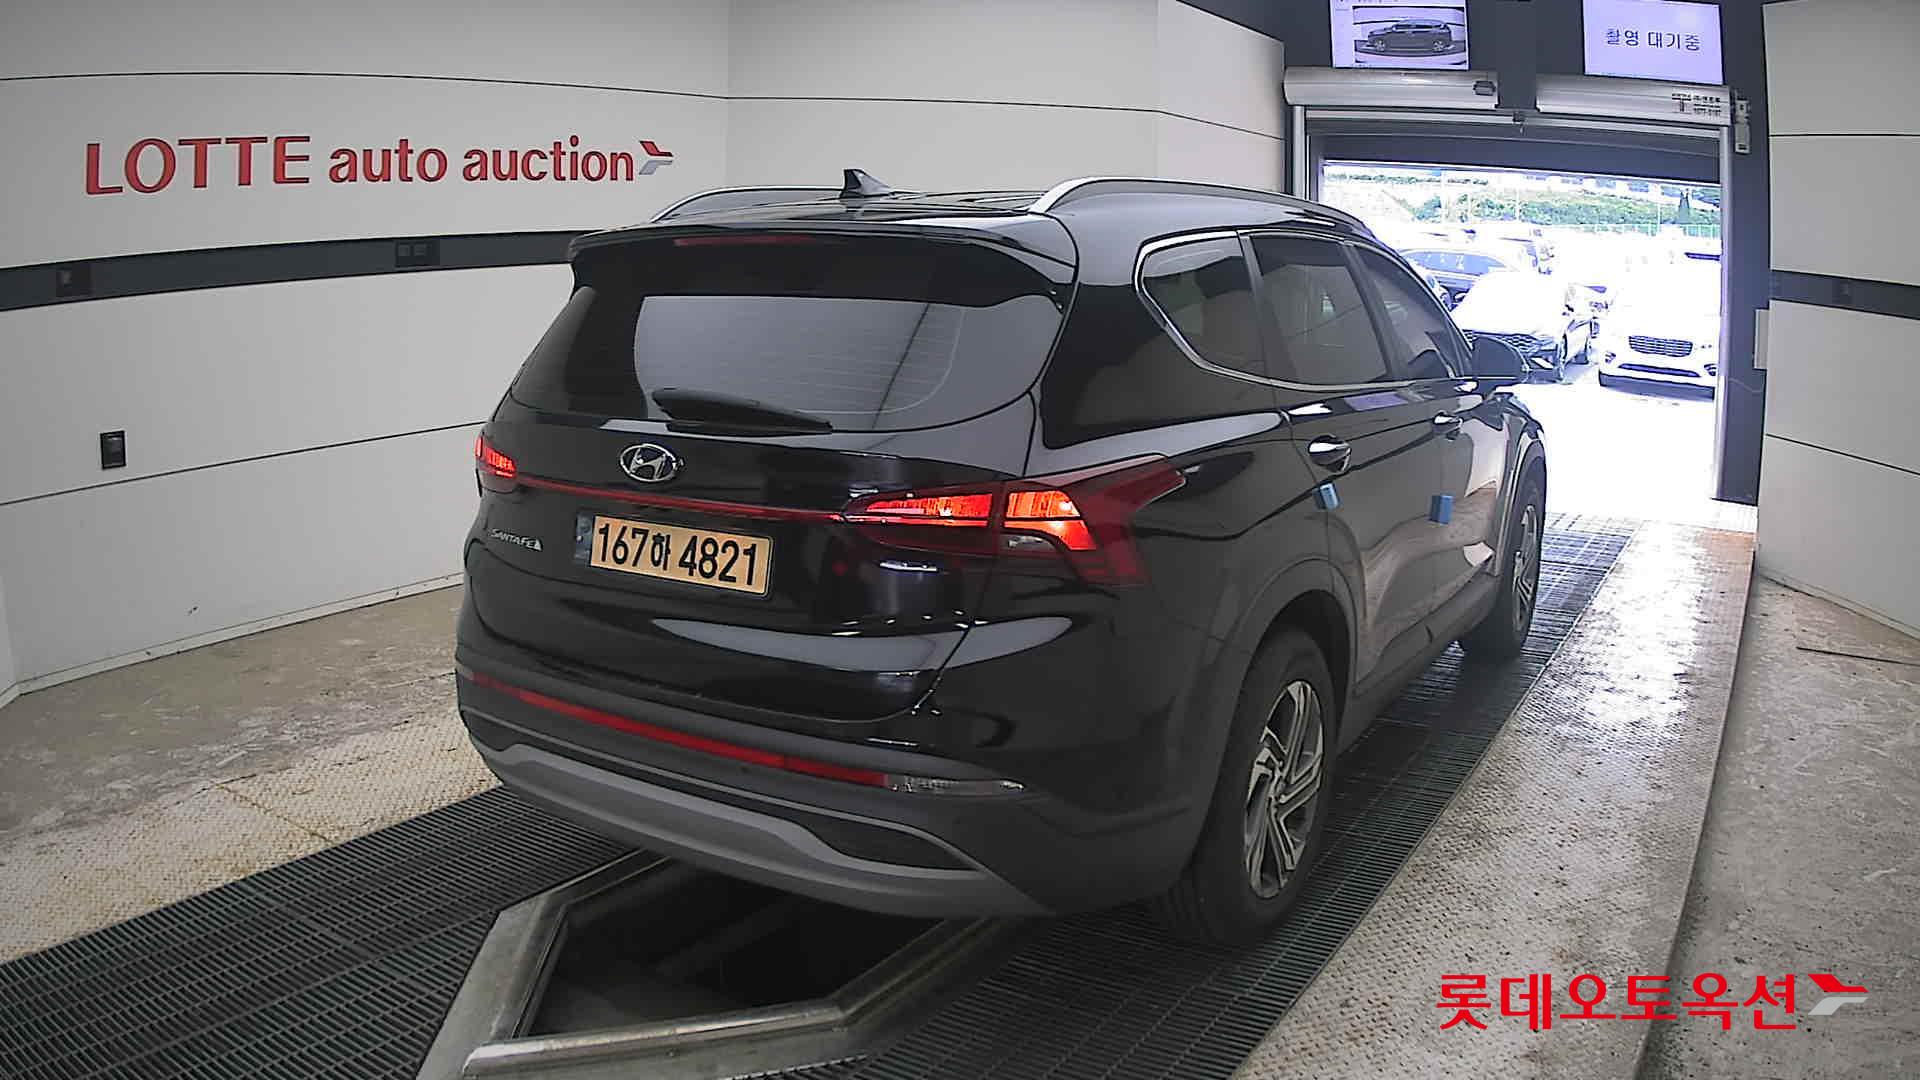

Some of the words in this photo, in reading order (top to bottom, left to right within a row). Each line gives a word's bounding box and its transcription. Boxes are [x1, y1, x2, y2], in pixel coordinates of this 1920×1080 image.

[1647, 30, 1701, 52] 대기중
[85, 135, 311, 195] LOTTE
[328, 138, 448, 183] auto
[462, 135, 635, 182] auction
[598, 522, 671, 571] 167하
[679, 535, 758, 586] 4821
